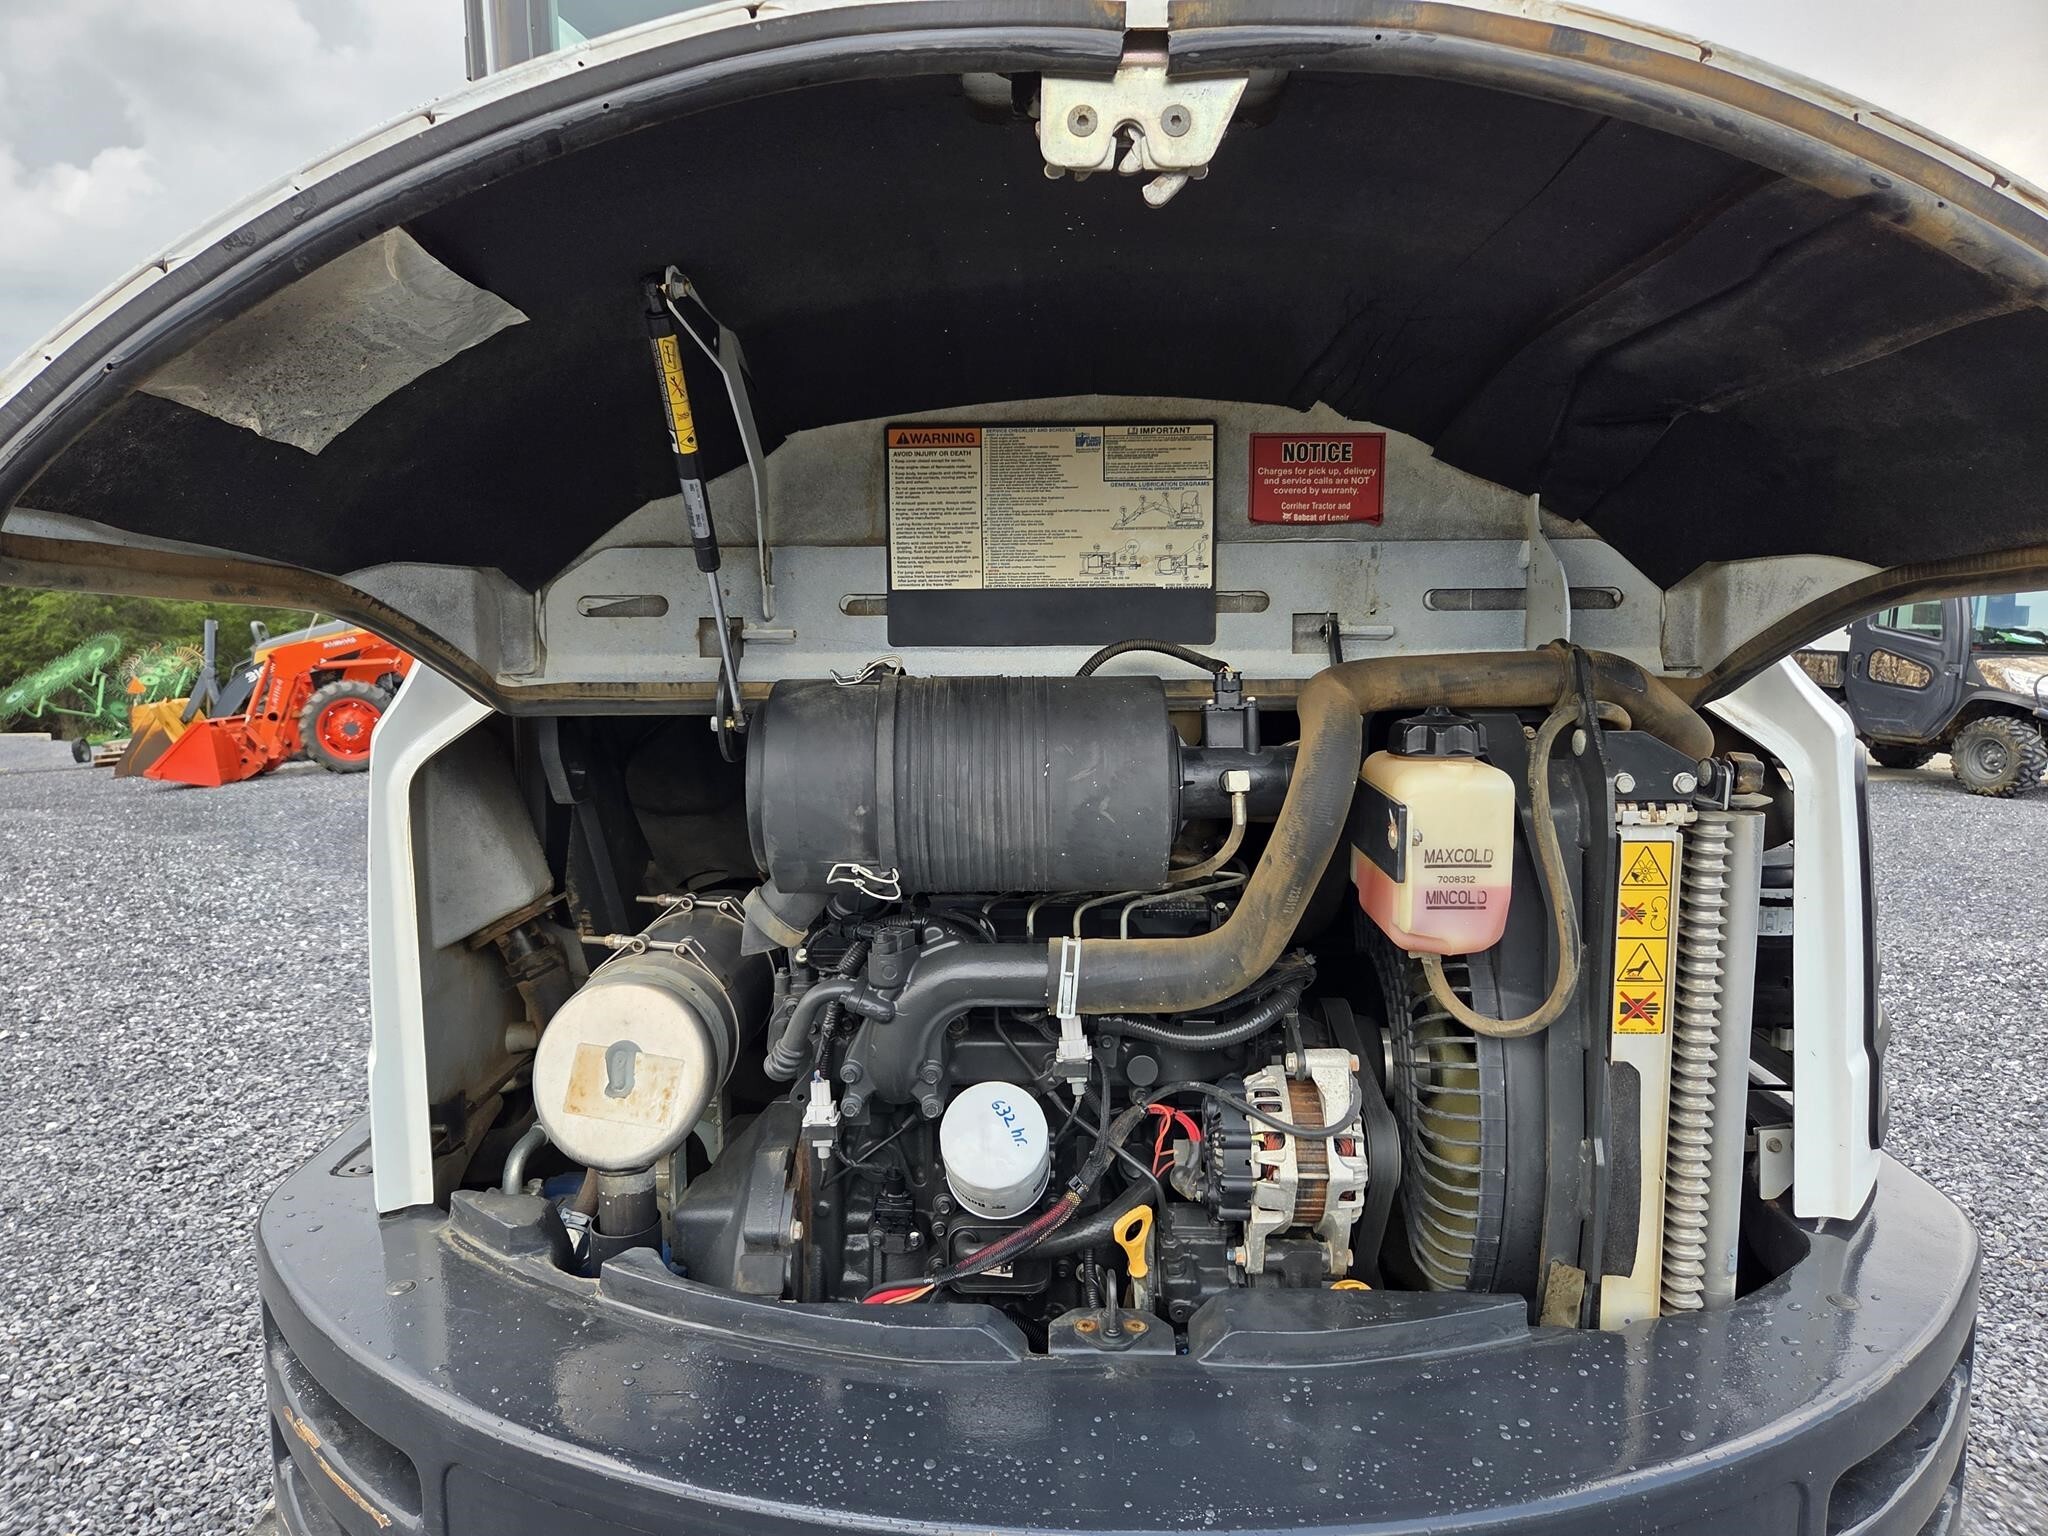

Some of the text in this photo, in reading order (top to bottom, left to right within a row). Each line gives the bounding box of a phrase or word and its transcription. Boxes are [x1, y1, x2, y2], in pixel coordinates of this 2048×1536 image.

[910, 432, 975, 444] WARNING
[1282, 442, 1353, 463] NOTICE
[1258, 467, 1292, 476] Charges
[1309, 467, 1326, 476] pick
[1344, 467, 1376, 476] delivery
[1309, 487, 1319, 495] by
[1424, 849, 1493, 863] MAXCOLD
[1425, 890, 1487, 905] MINCOLD
[991, 1100, 1028, 1147] 632 hr.
